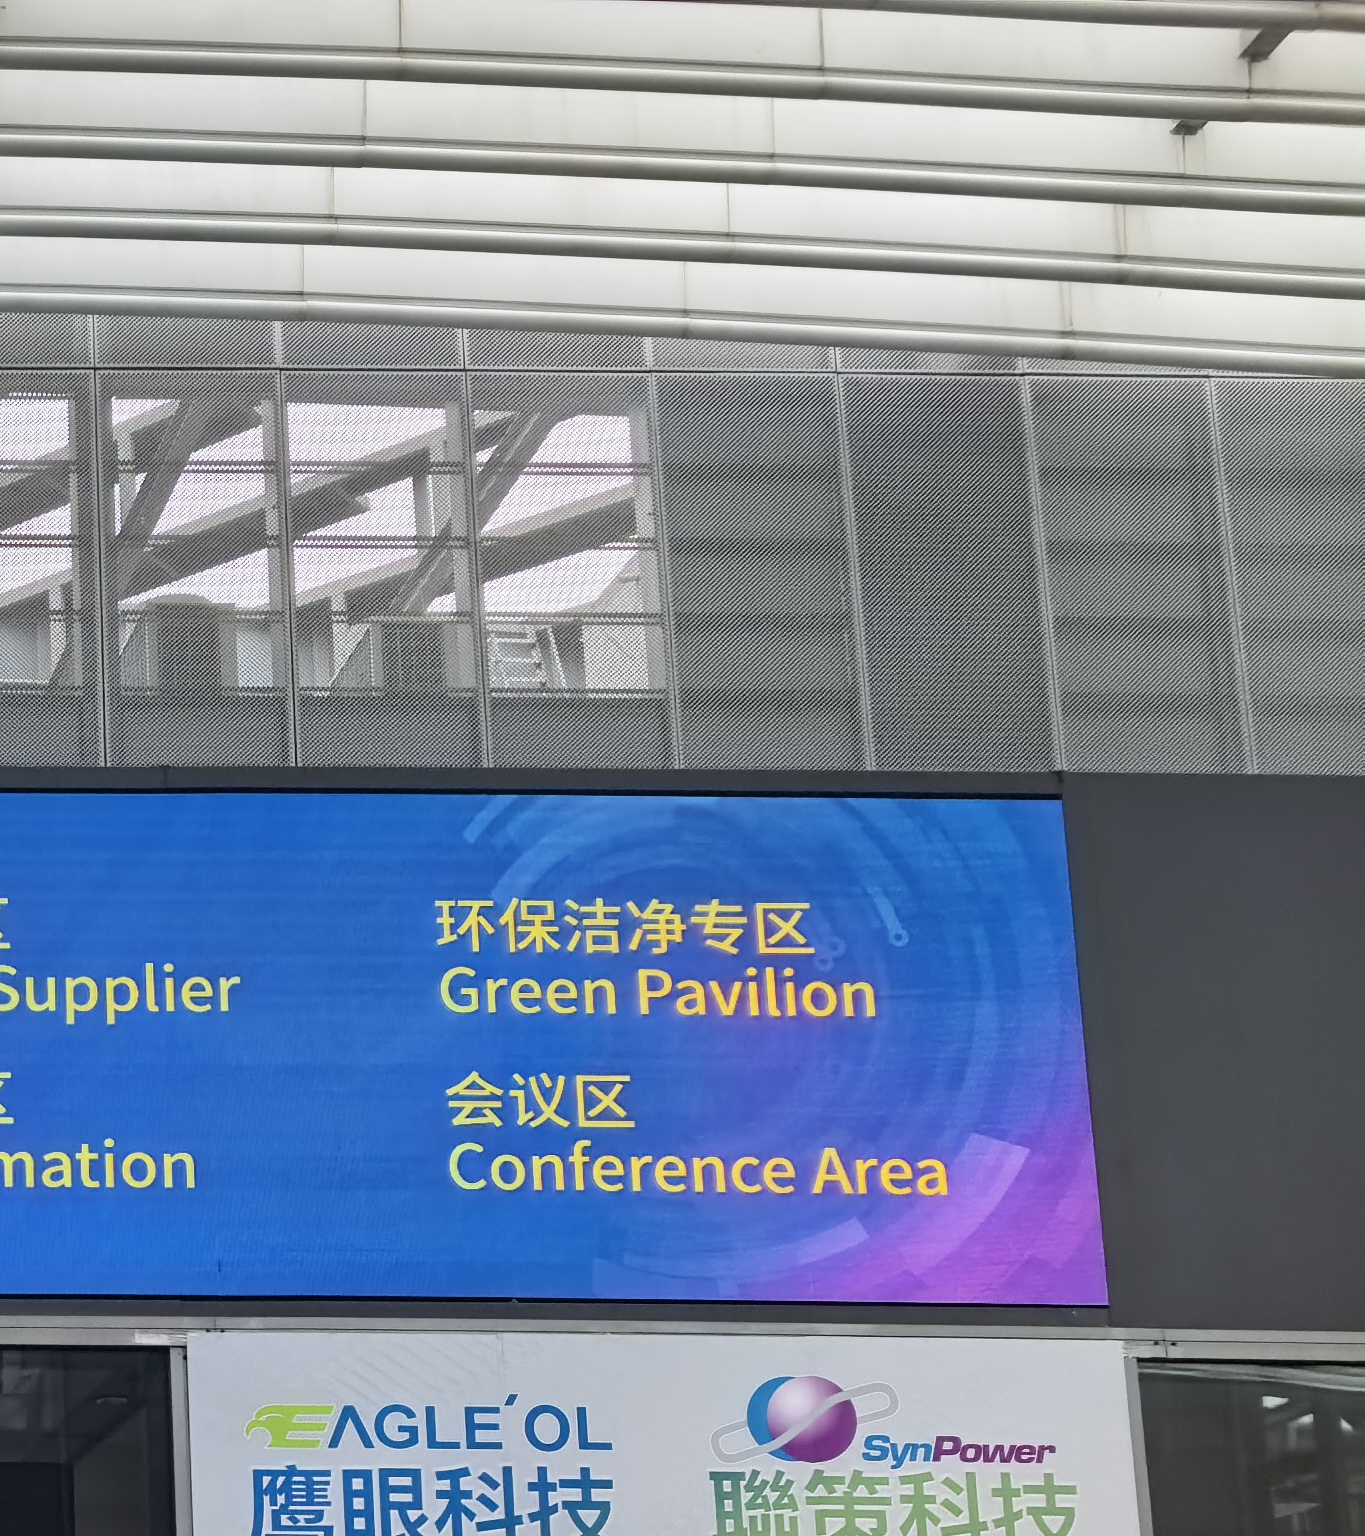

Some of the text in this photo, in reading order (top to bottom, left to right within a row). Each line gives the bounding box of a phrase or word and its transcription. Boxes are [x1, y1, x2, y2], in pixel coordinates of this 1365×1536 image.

[435, 898, 815, 955] 环保洁净专区
[440, 966, 877, 1018] Green Pavilion
[445, 1070, 635, 1128] 会议区
[448, 1140, 948, 1196] Conference Area
[861, 1432, 1057, 1466] SynPower
